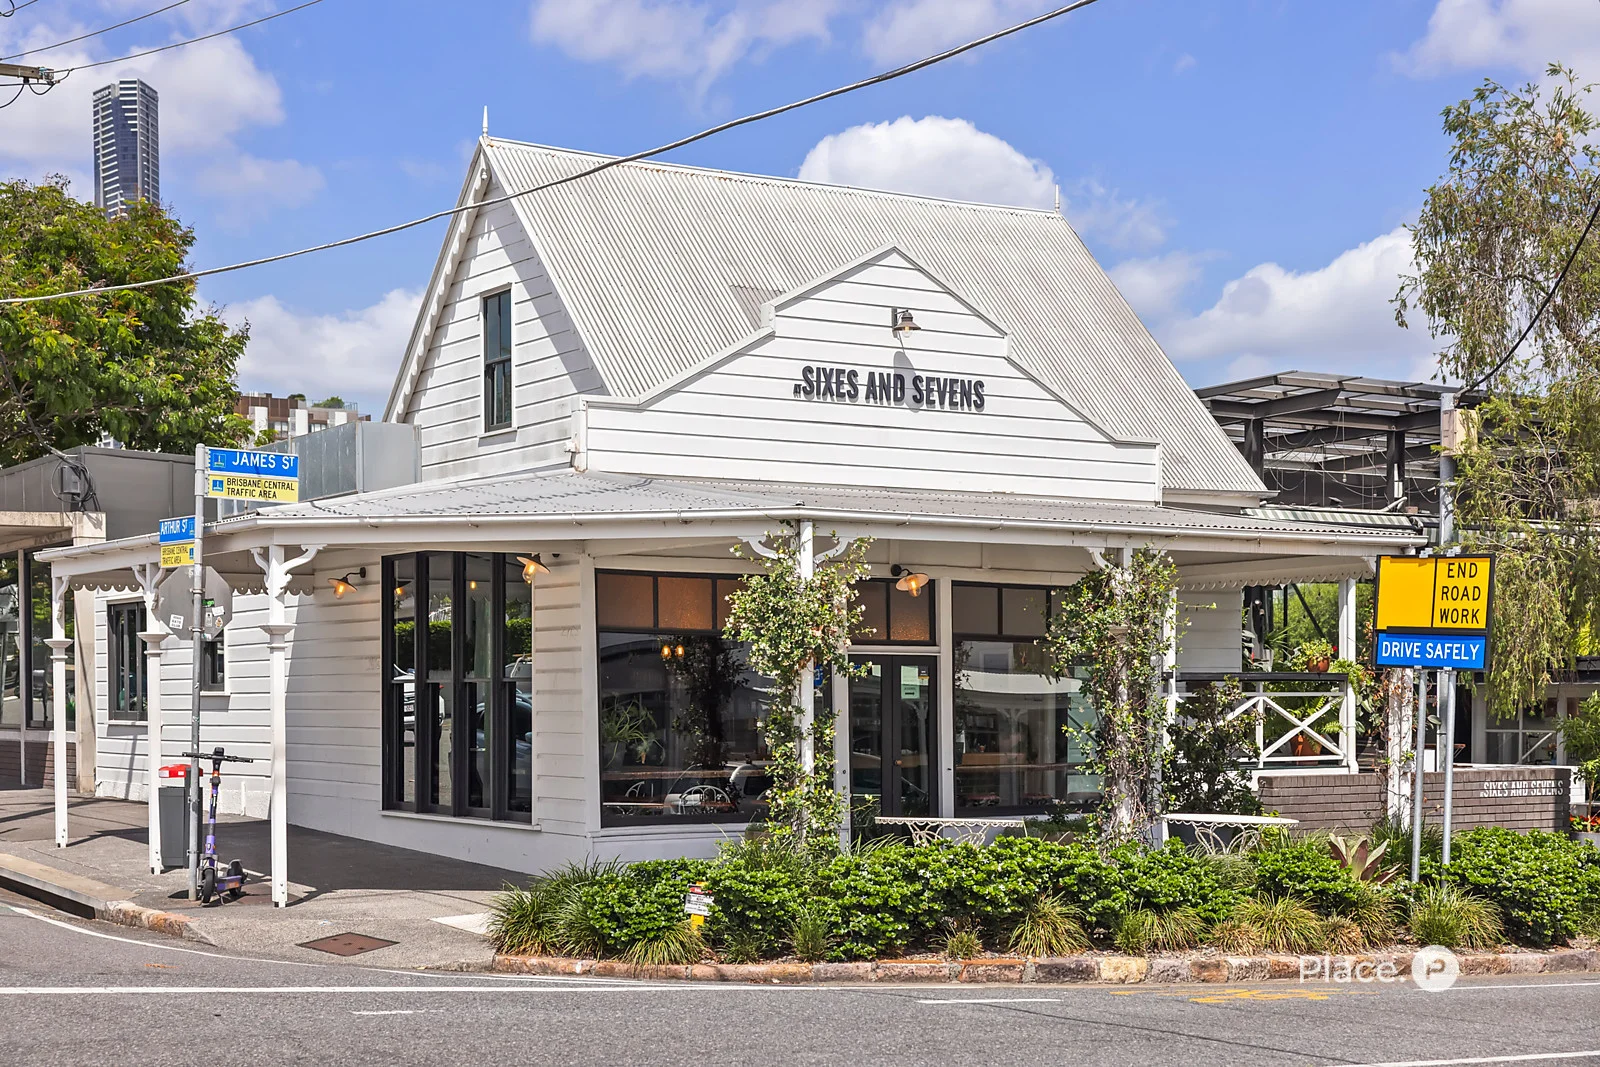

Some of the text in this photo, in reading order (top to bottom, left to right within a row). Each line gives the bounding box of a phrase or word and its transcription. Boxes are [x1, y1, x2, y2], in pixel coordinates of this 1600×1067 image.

[802, 365, 859, 400] SIXES
[865, 371, 905, 403] AND
[912, 374, 985, 409] SEVENS
[232, 452, 295, 470] JAMES ST
[226, 477, 295, 491] BRISBANE CENTRAL
[226, 487, 277, 499] TRAFFIC AREA
[160, 520, 181, 535] ARTHUR
[1447, 562, 1478, 579] END
[1441, 585, 1481, 601] ROAD
[1439, 608, 1480, 624] WORK
[1381, 641, 1480, 661] DRIVE SAFELY
[1483, 781, 1508, 798] SIXES
[1510, 780, 1529, 797] AND
[1530, 779, 1564, 797] SEVENS
